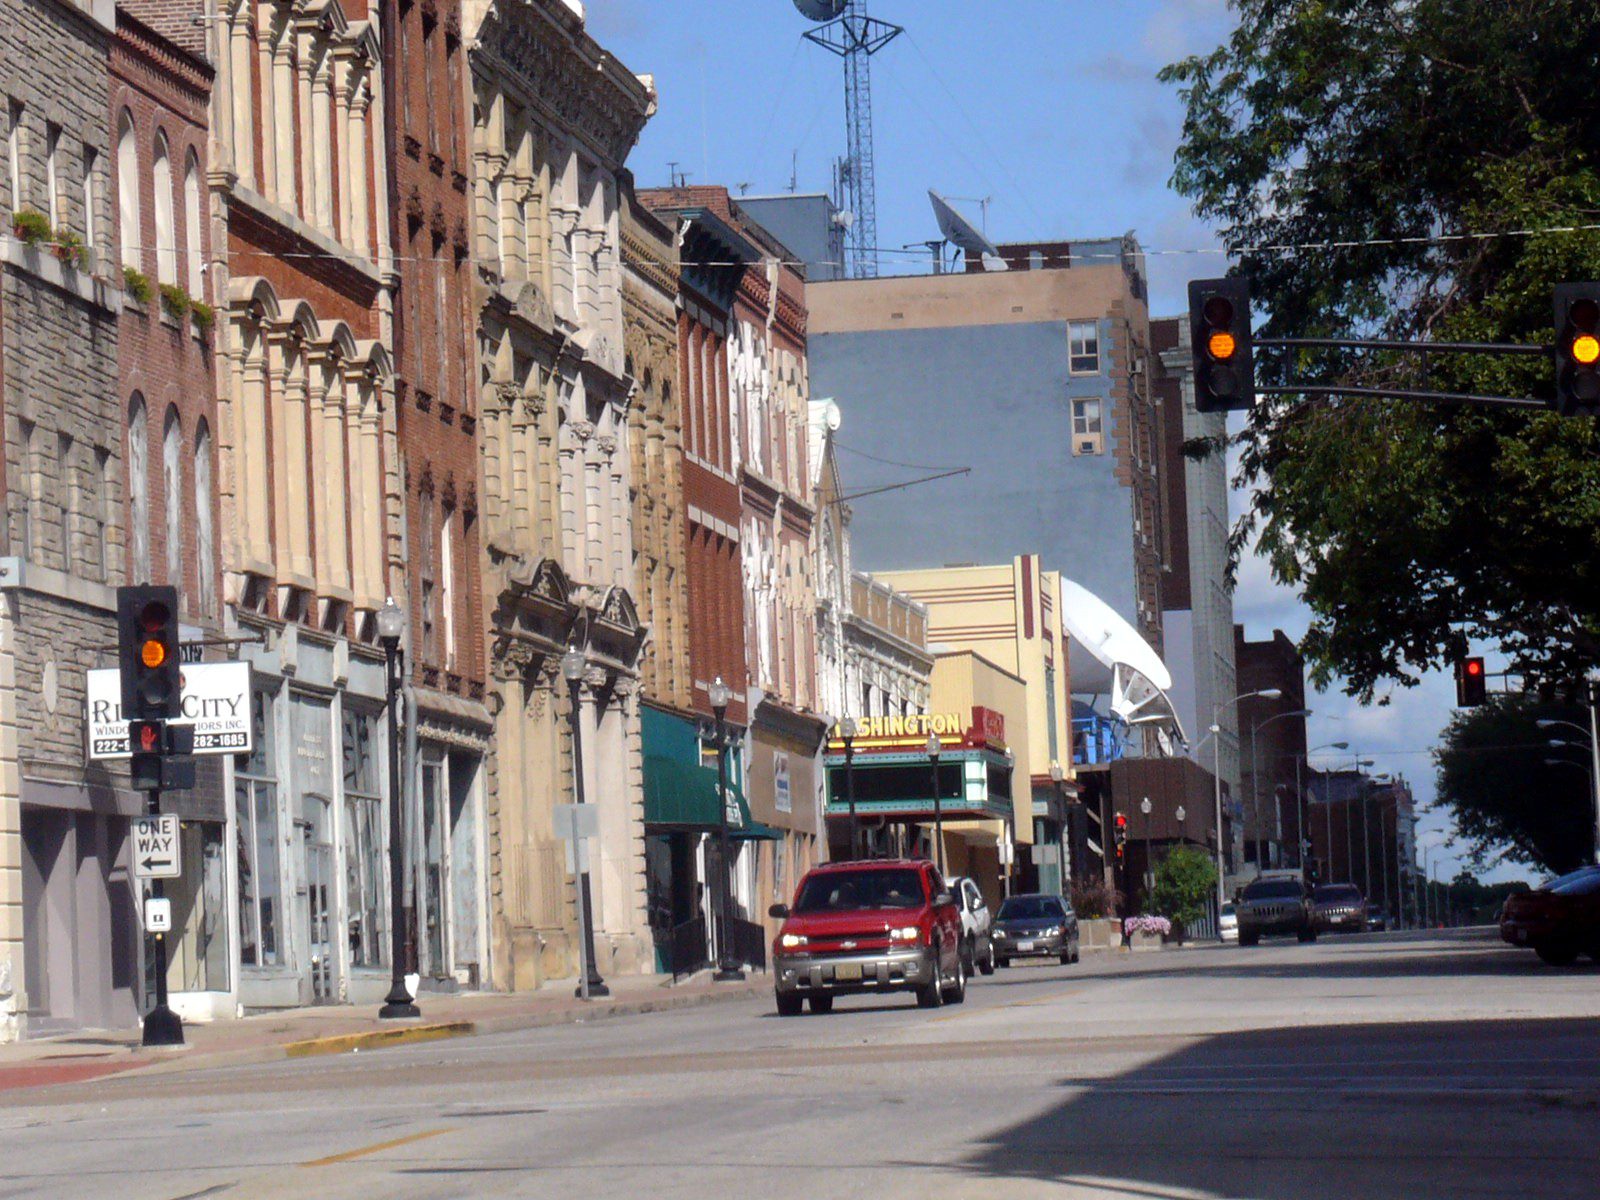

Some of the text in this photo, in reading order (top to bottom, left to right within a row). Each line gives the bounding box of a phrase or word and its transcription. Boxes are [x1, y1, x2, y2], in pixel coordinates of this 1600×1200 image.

[181, 693, 243, 718] CITY
[95, 726, 129, 736] WINDO
[834, 713, 960, 738] SHINGTON
[194, 733, 245, 748] 282-1685
[139, 820, 171, 835] ONE
[138, 838, 172, 853] WAY
